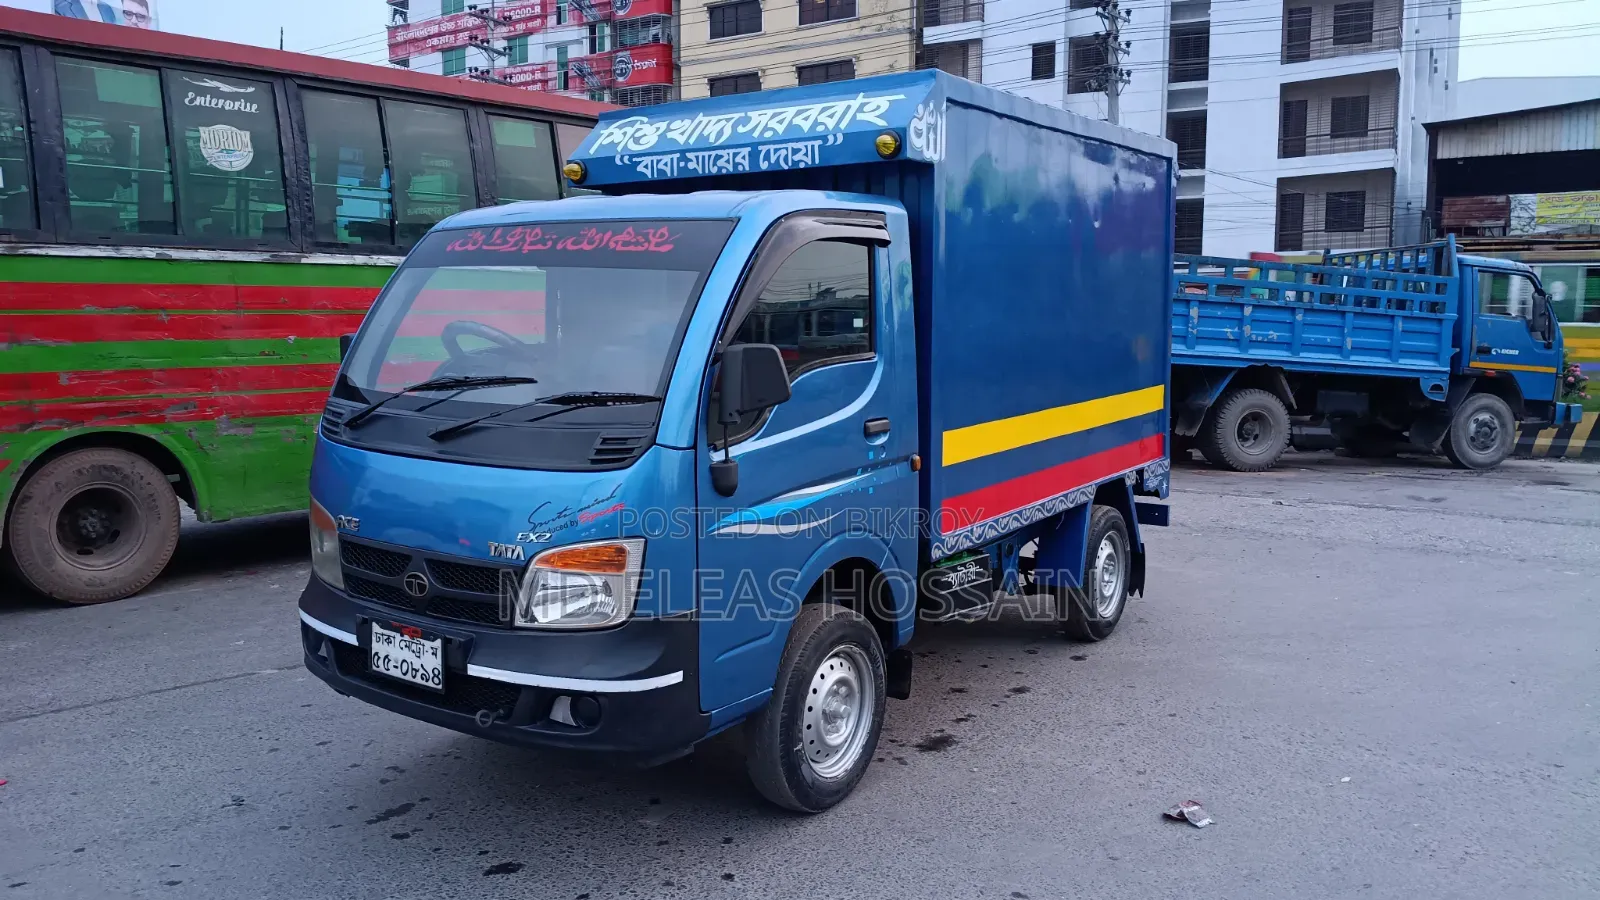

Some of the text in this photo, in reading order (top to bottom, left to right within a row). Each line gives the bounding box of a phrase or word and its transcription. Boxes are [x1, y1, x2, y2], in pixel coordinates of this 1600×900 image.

[184, 91, 260, 114] Enterprise
[200, 128, 252, 153] MORIOM
[570, 519, 579, 528] by
[516, 532, 553, 543] EX2
[488, 541, 526, 561] TATA
[374, 631, 397, 649] ঢাকা
[372, 651, 442, 687] ৫৫-০৮৯৪
